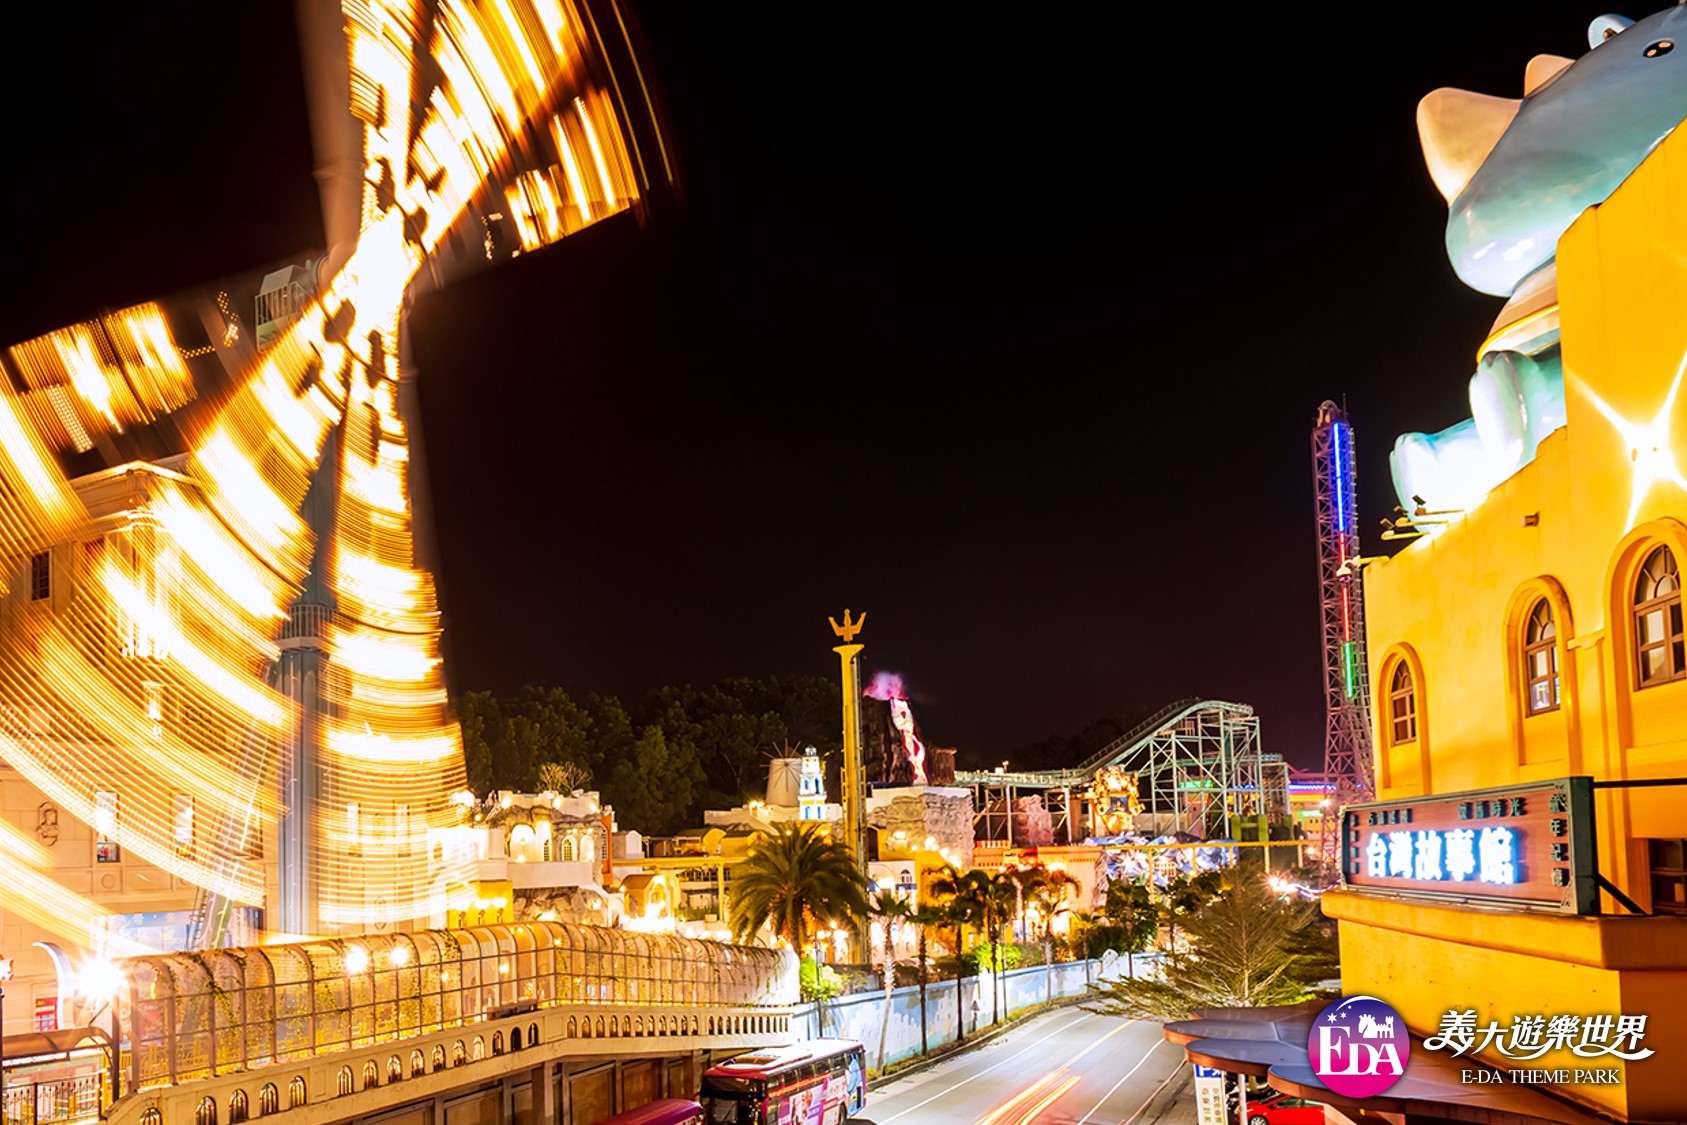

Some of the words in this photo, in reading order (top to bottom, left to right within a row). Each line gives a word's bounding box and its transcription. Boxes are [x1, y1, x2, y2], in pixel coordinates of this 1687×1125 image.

[1366, 826, 1514, 885] 台灣故事館
